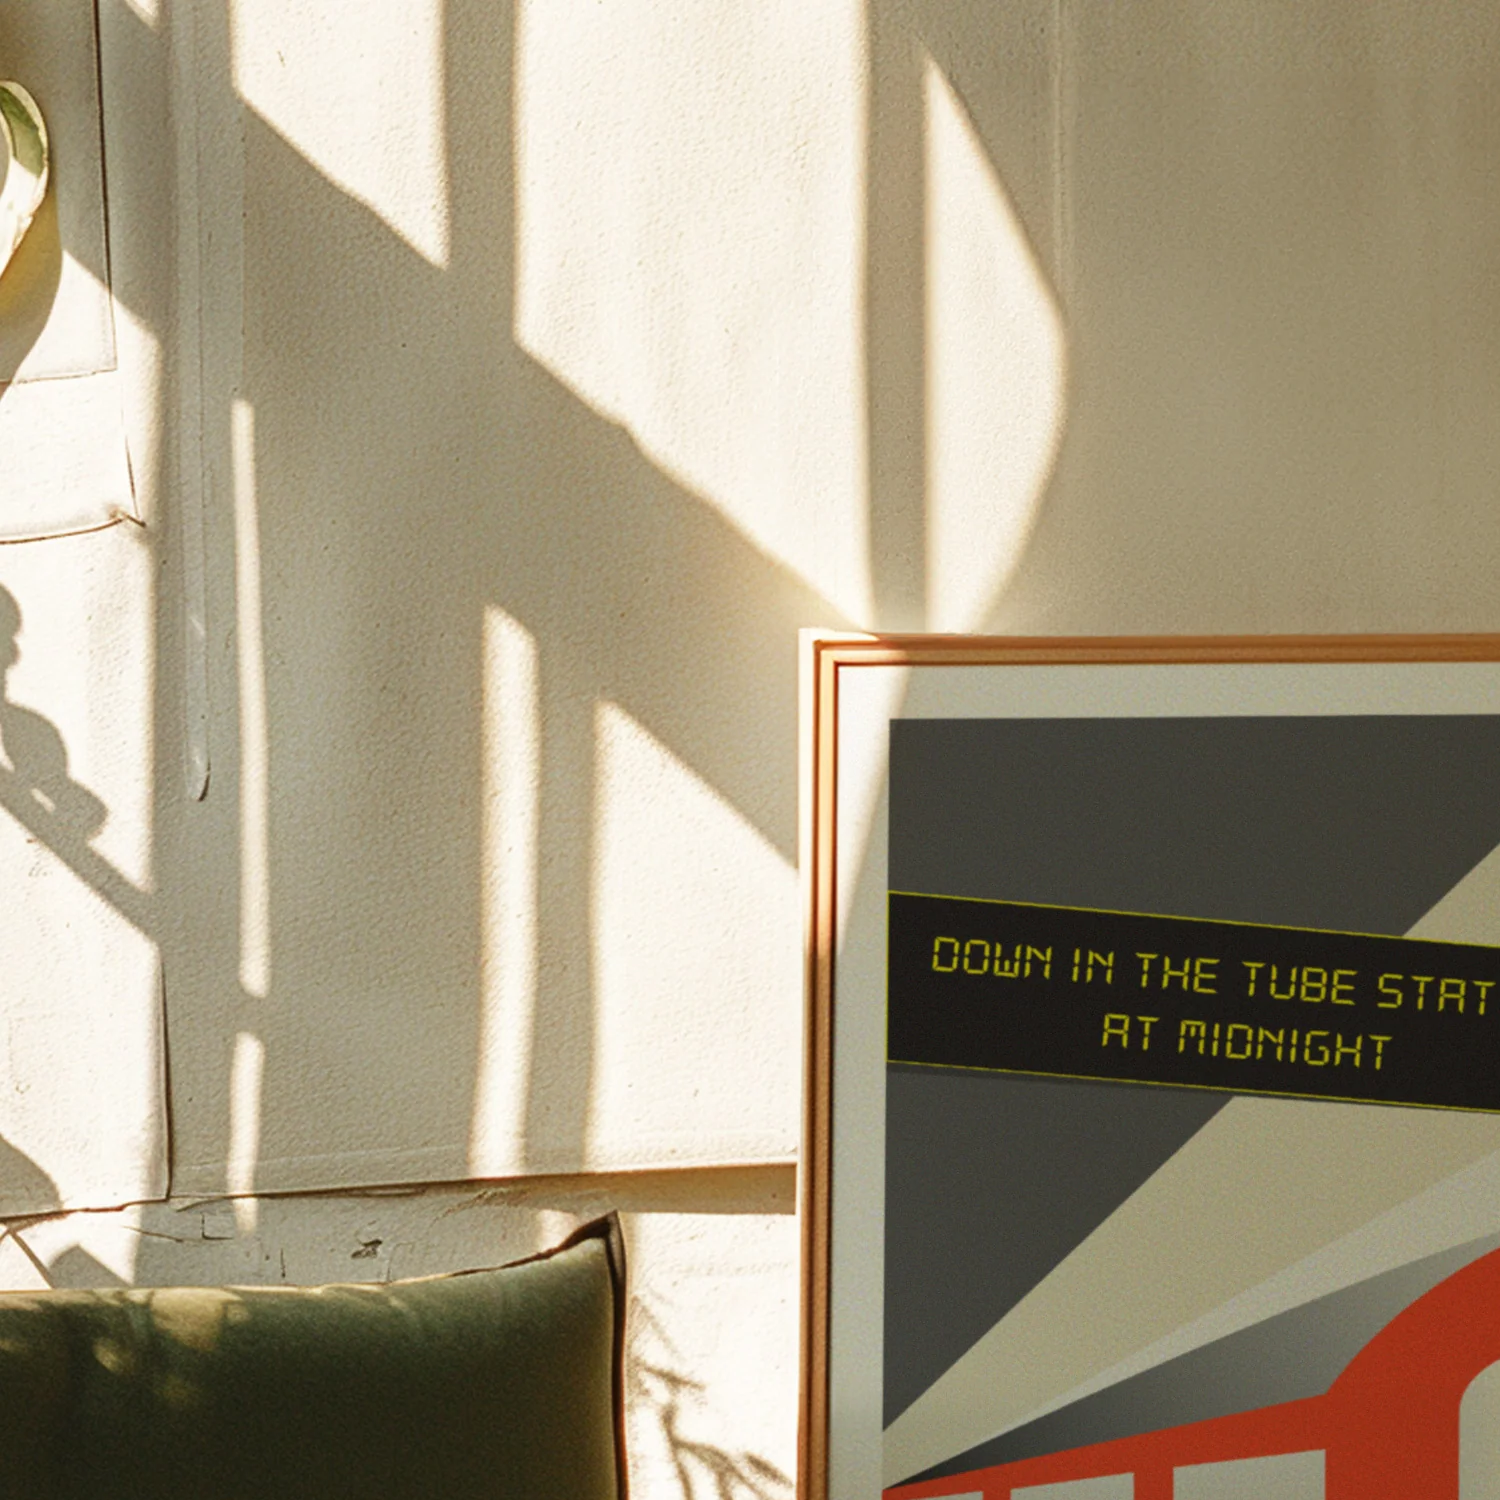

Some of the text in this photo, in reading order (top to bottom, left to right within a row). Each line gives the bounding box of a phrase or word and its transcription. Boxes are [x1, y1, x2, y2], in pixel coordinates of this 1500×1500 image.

[932, 936, 1053, 980] DOWN
[1072, 947, 1115, 984] IN
[1136, 952, 1220, 995] THE
[1243, 961, 1358, 1006] TUBE
[1102, 1013, 1393, 1071] AT MIDNIGHT
